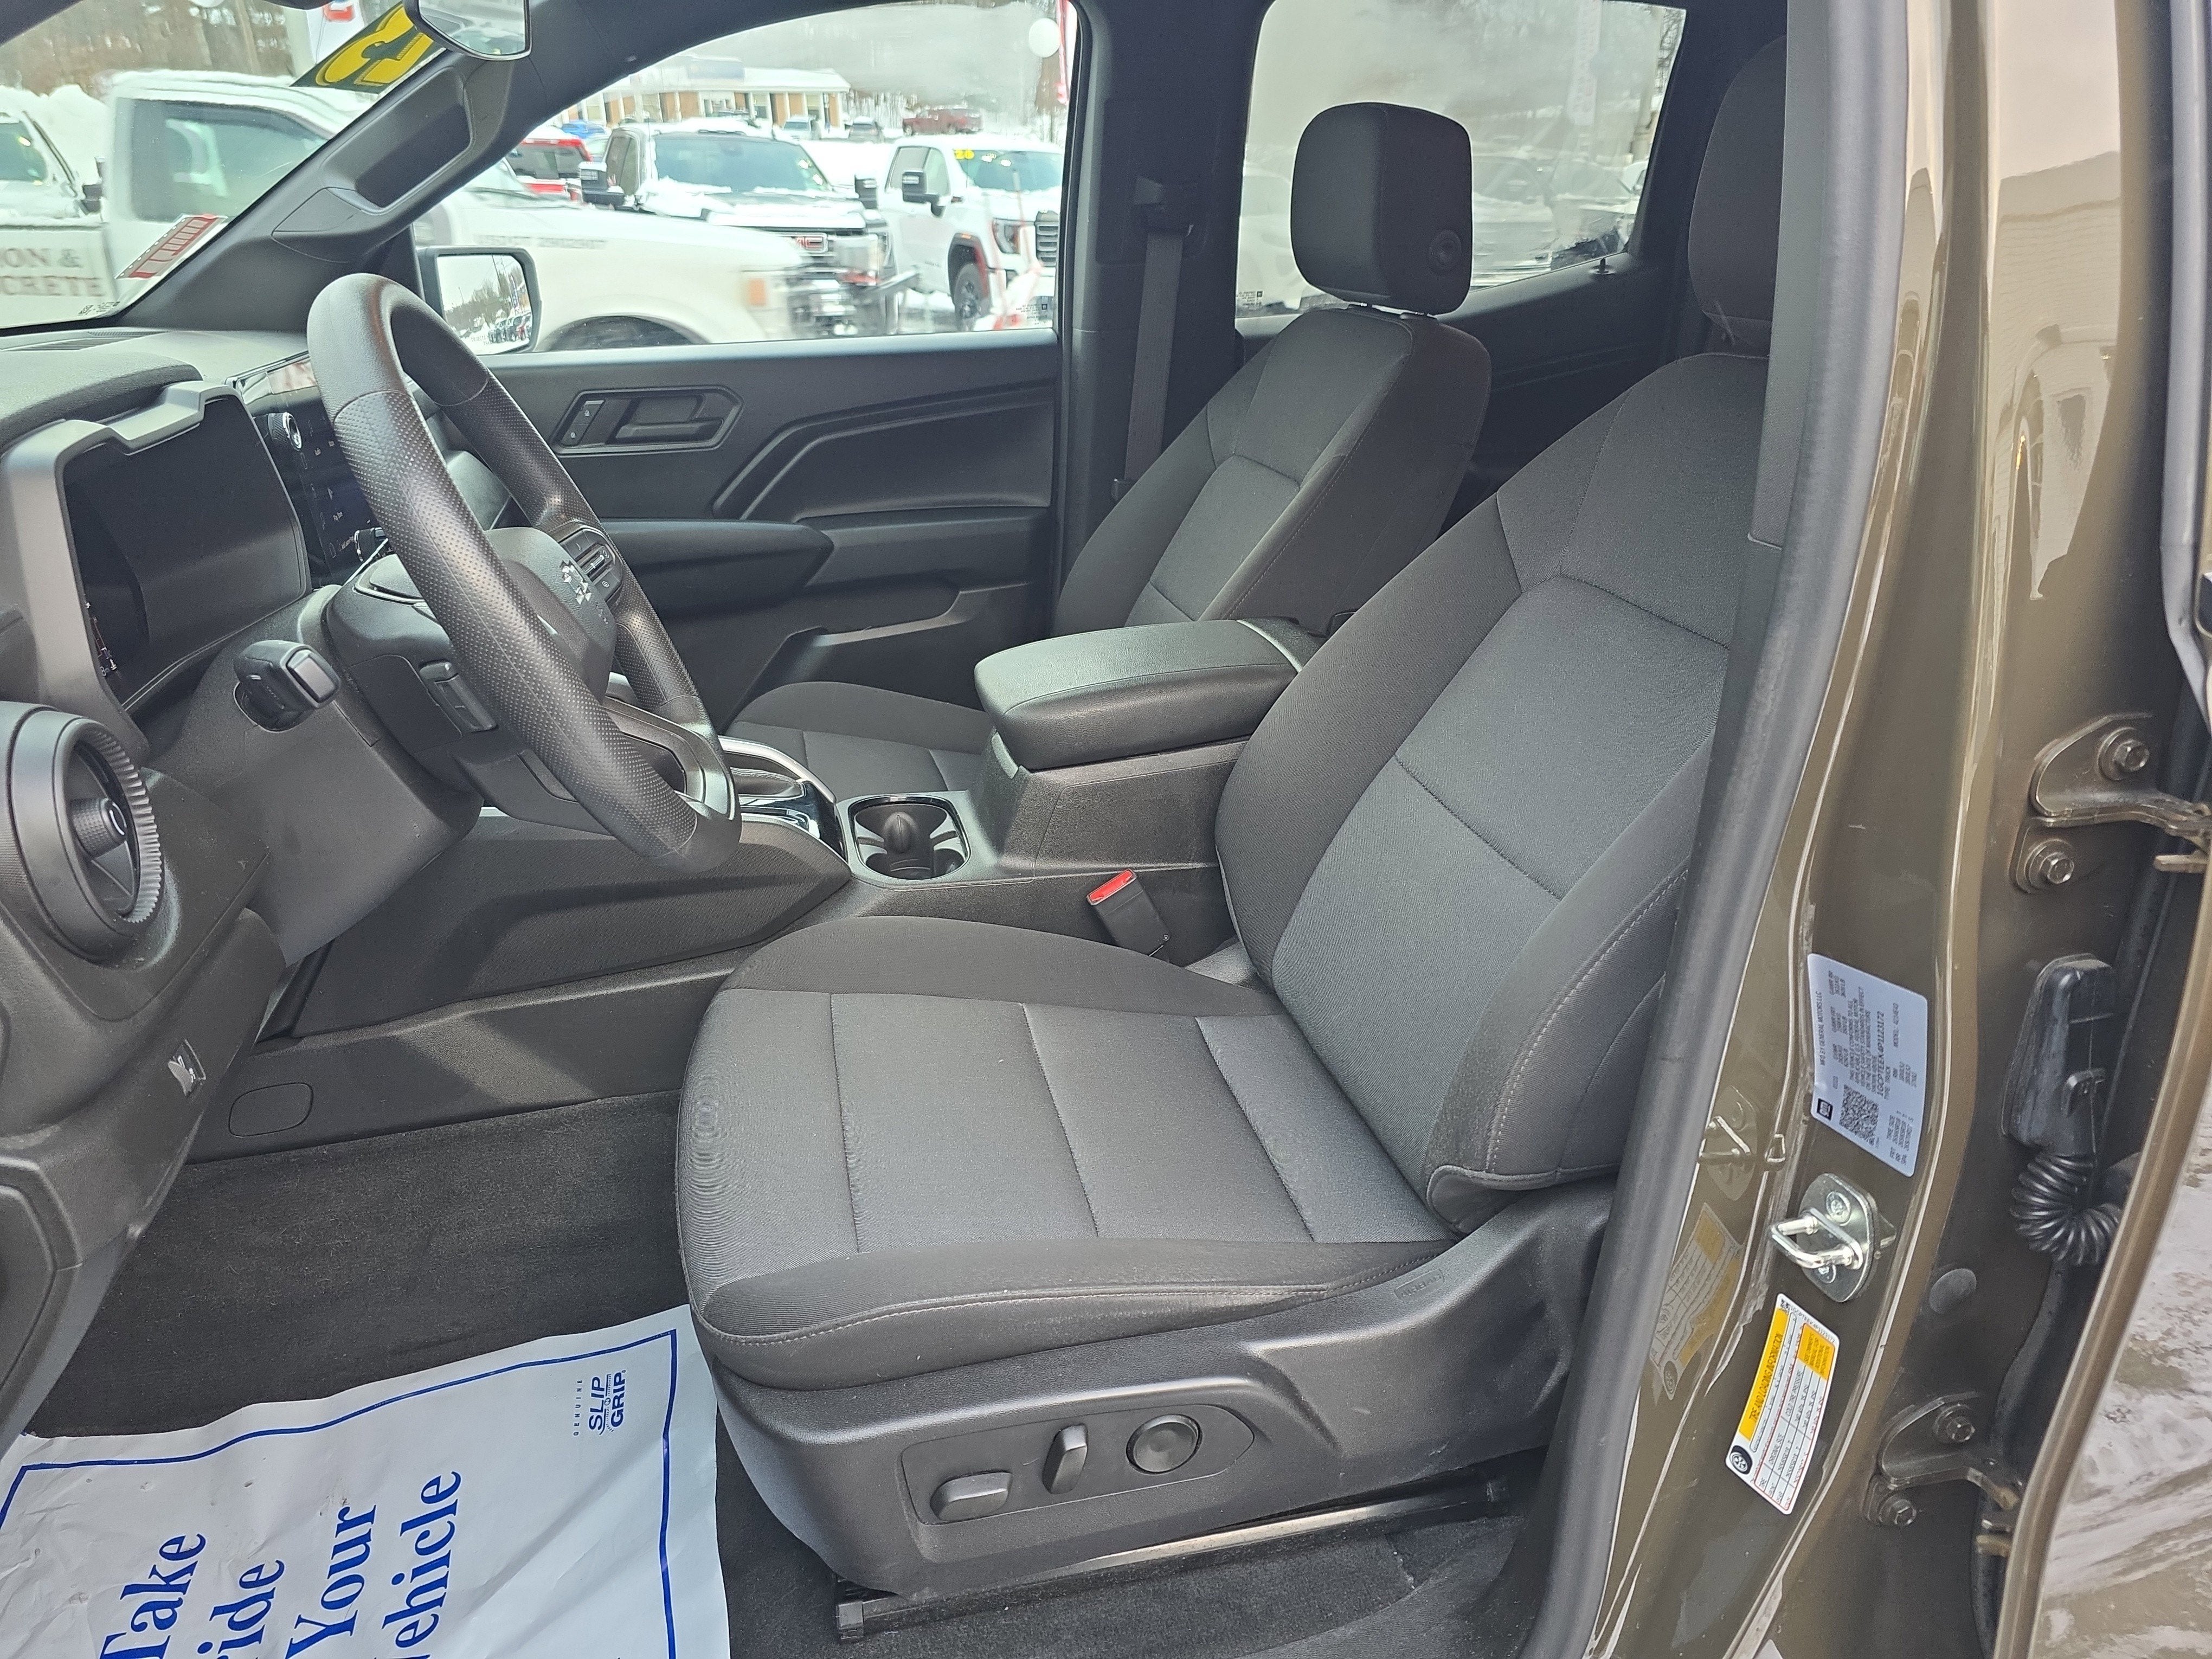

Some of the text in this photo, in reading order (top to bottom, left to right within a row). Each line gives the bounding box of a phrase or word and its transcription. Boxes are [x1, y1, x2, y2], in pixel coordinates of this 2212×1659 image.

[1866, 1049, 1870, 1057] OF
[1766, 1333, 1783, 1373] INFORMATION
[1759, 1368, 1773, 1397] LOADING
[1792, 1369, 1803, 1392] PRESSURE
[573, 1379, 583, 1437] GENUINE
[588, 1376, 606, 1431] SLIP
[1749, 1405, 1760, 1420] TIRE
[1754, 1392, 1764, 1409] AND
[1769, 1443, 1779, 1465] ORIGINAL
[1759, 1477, 1767, 1489] TIRE
[285, 1504, 377, 1659] Your
[374, 1470, 462, 1659] ehicle
[99, 1533, 207, 1659] Take
[197, 1559, 286, 1659] ide
